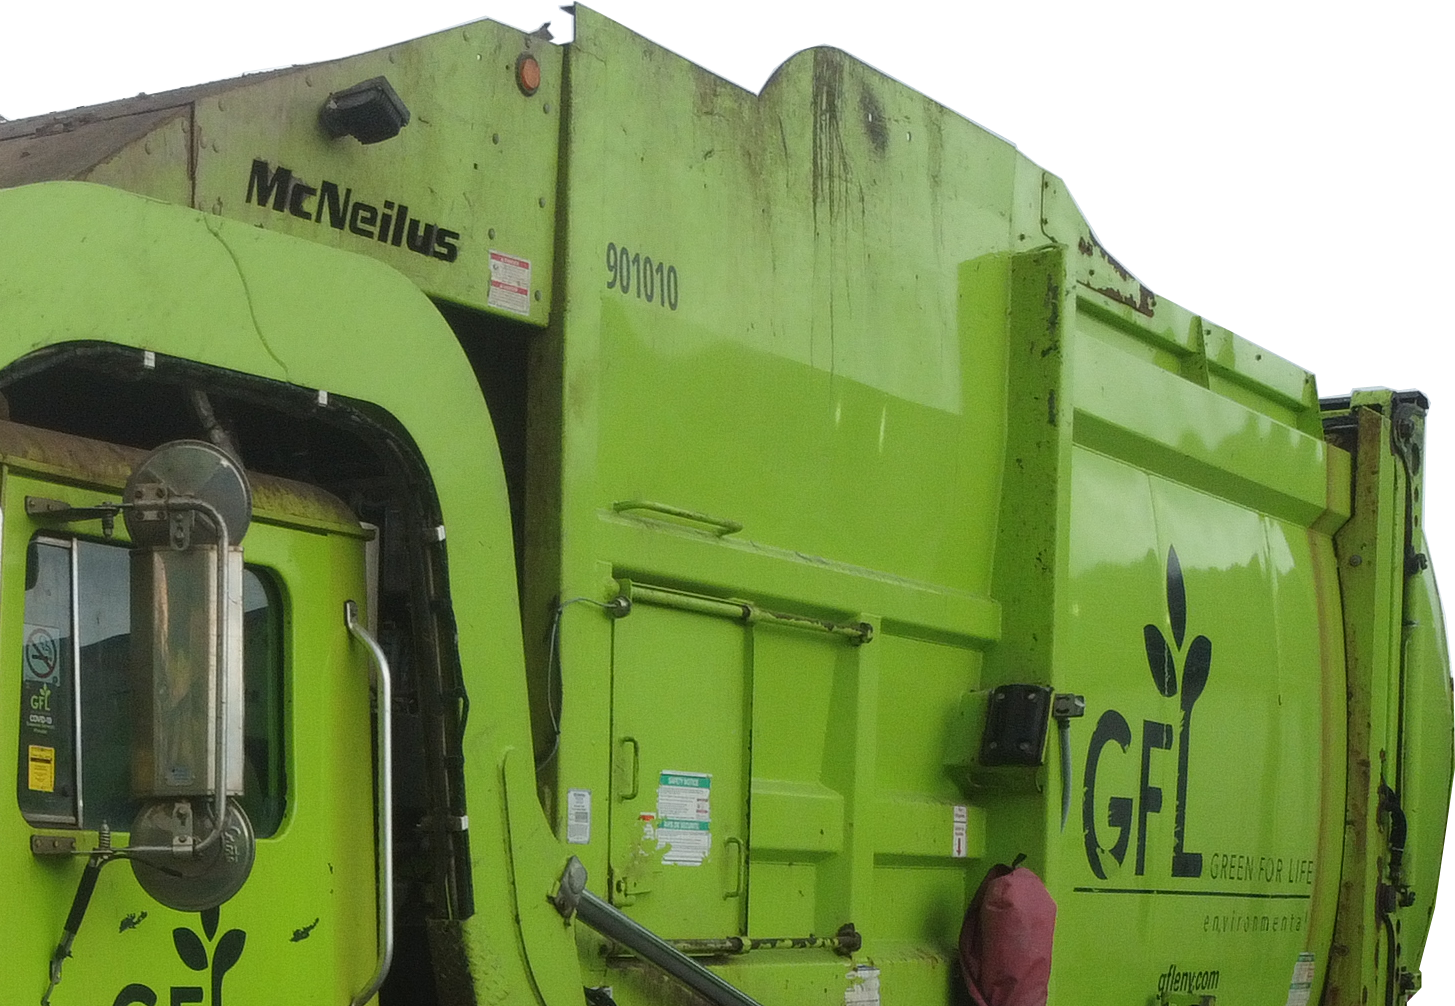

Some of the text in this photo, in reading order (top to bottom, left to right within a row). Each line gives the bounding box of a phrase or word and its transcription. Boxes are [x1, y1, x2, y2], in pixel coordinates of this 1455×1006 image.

[245, 158, 461, 264] McNeilus
[606, 242, 678, 311] 901010
[30, 690, 51, 711] GFL
[1082, 637, 1212, 880] GFL
[1210, 853, 1314, 885] GREEN FOR LIFE
